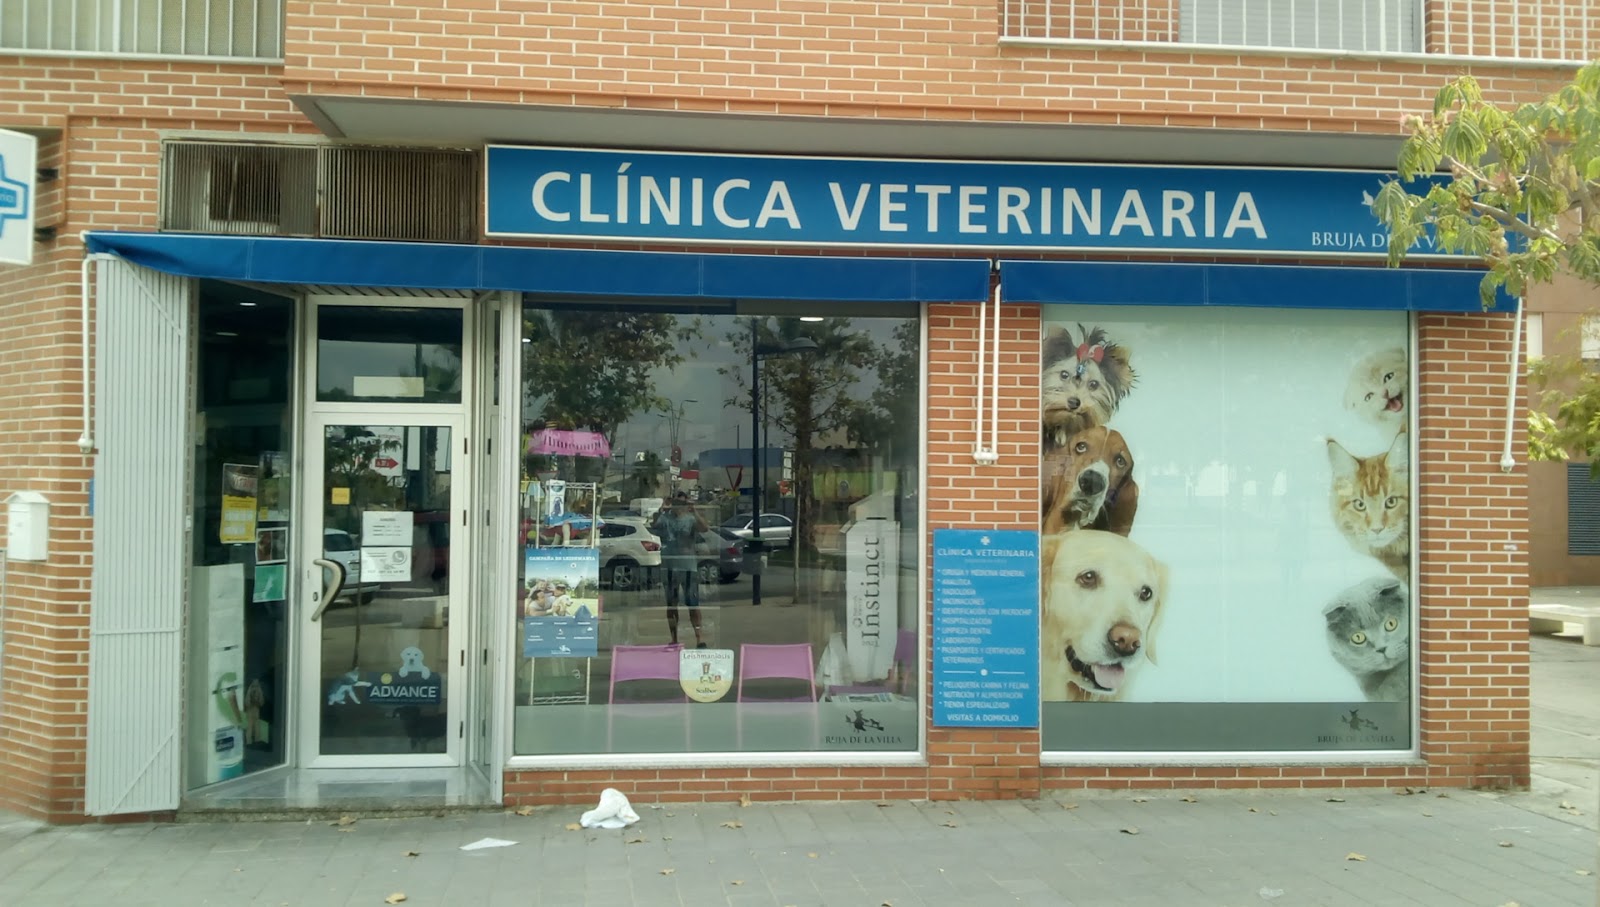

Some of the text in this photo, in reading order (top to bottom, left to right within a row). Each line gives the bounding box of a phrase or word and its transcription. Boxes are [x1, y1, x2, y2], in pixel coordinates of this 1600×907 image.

[531, 162, 1268, 239] CLÍNICA VETERINARIA
[1311, 231, 1366, 250] BRUJA
[937, 547, 1035, 558] CLÍNICA VETERINARIA
[861, 537, 880, 640] Instinct
[985, 647, 1026, 655] CERTIFICADOS
[370, 685, 437, 698] ADVANCE
[1008, 682, 1030, 690] FELINA
[944, 701, 1011, 709] TIENDA ESPECIALIZADA
[947, 714, 974, 722] VISITAS
[982, 714, 1020, 722] DOMICILIO
